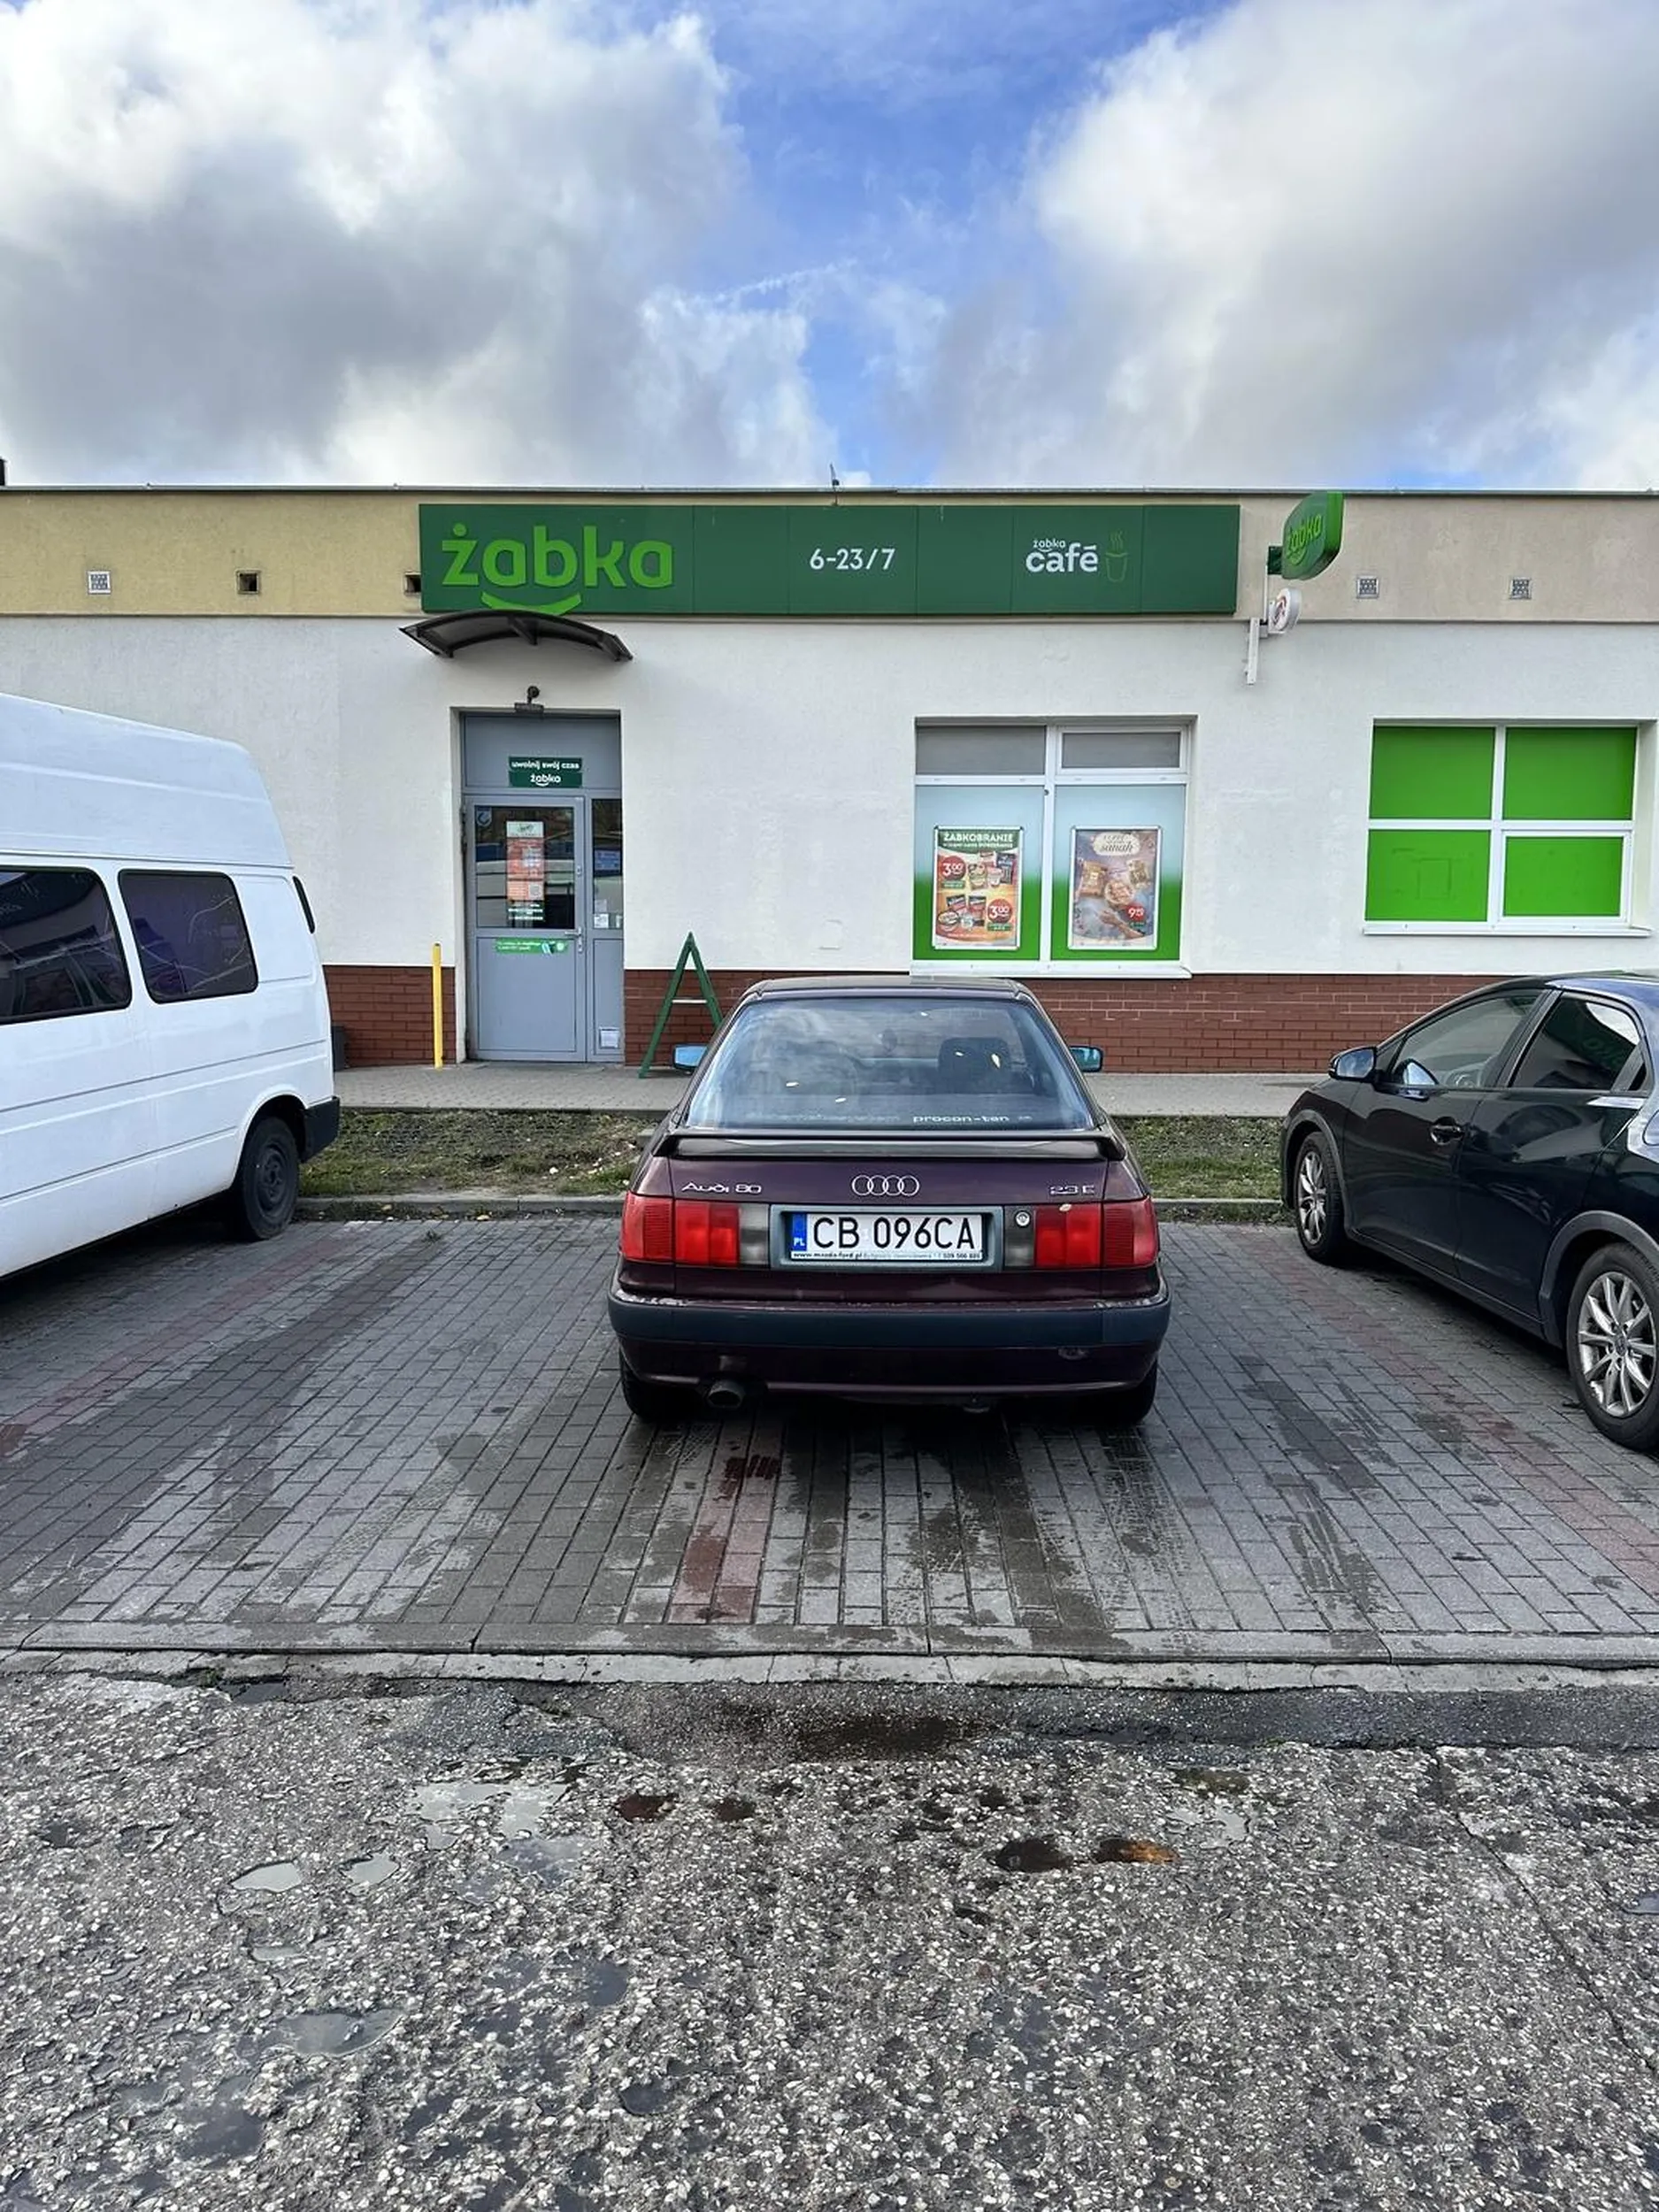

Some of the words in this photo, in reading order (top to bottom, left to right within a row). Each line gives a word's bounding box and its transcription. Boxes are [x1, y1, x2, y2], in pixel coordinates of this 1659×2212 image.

[442, 523, 673, 588] żabka
[810, 549, 895, 570] 6-23/7
[1025, 542, 1099, 572] café
[680, 1182, 730, 1193] Audi
[735, 1184, 762, 1194] 80
[794, 1237, 804, 1246] PL
[813, 1217, 859, 1248] CB
[873, 1217, 975, 1248] 096CA
